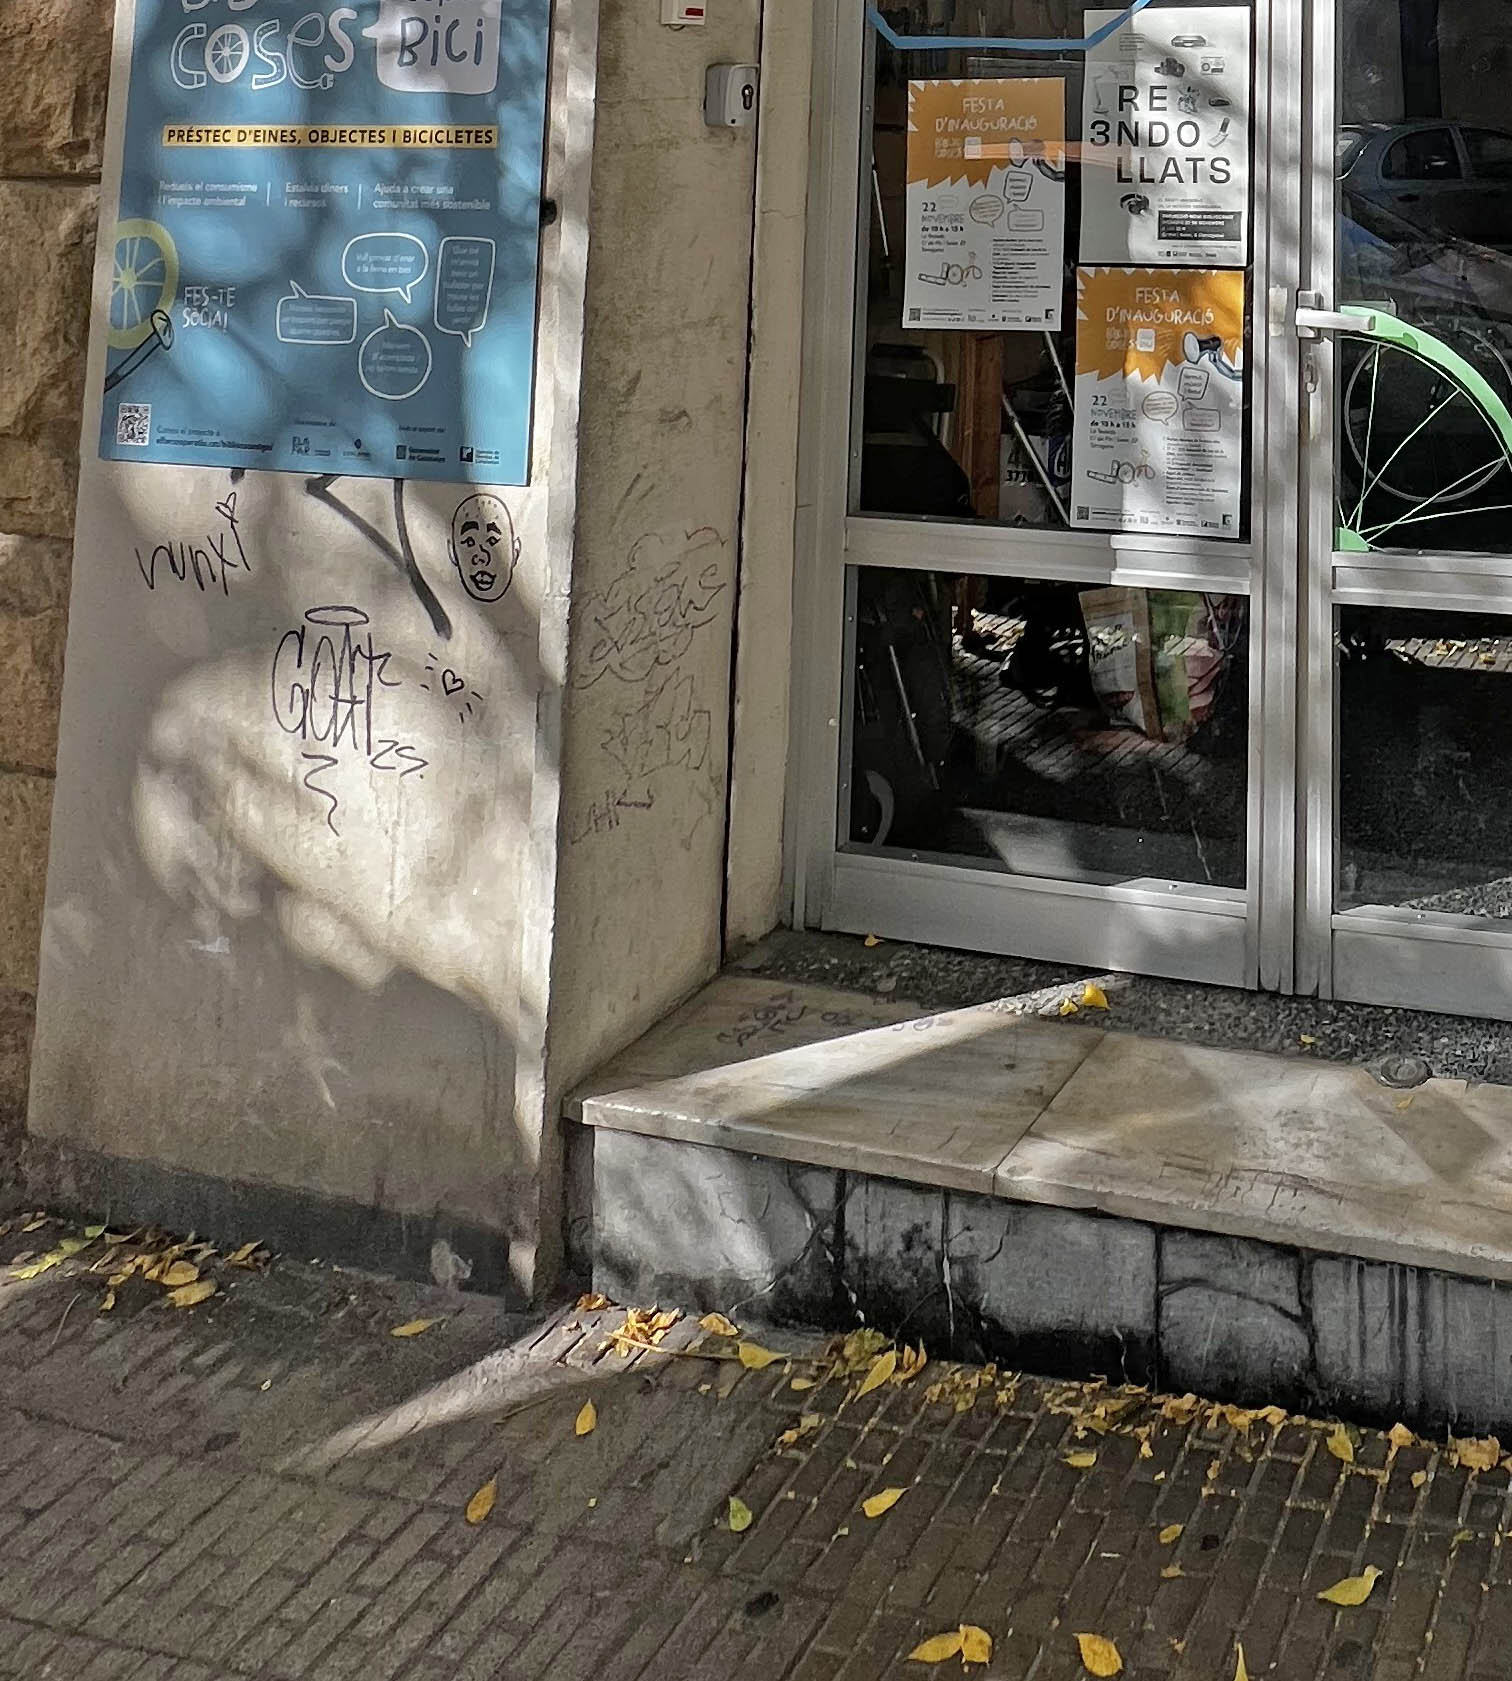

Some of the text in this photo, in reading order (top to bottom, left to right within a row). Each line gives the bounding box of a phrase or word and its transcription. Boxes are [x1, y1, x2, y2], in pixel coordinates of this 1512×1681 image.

[963, 97, 1005, 113] FESTA
[1118, 85, 1168, 112] RE
[935, 115, 1037, 133] D'INAUGURACIÓ
[167, 125, 232, 144] PRÉSTEC
[237, 127, 302, 146] D'EINES,
[308, 129, 386, 144] OBJECTES
[402, 129, 494, 145] BICICLETES
[1116, 157, 1231, 184] LLATS
[921, 202, 936, 212] 22
[183, 286, 236, 307] FES-TE
[1135, 287, 1180, 304] FESTA
[1106, 306, 1214, 325] D'INAUGURACIÓ
[1092, 395, 1108, 406] 22
